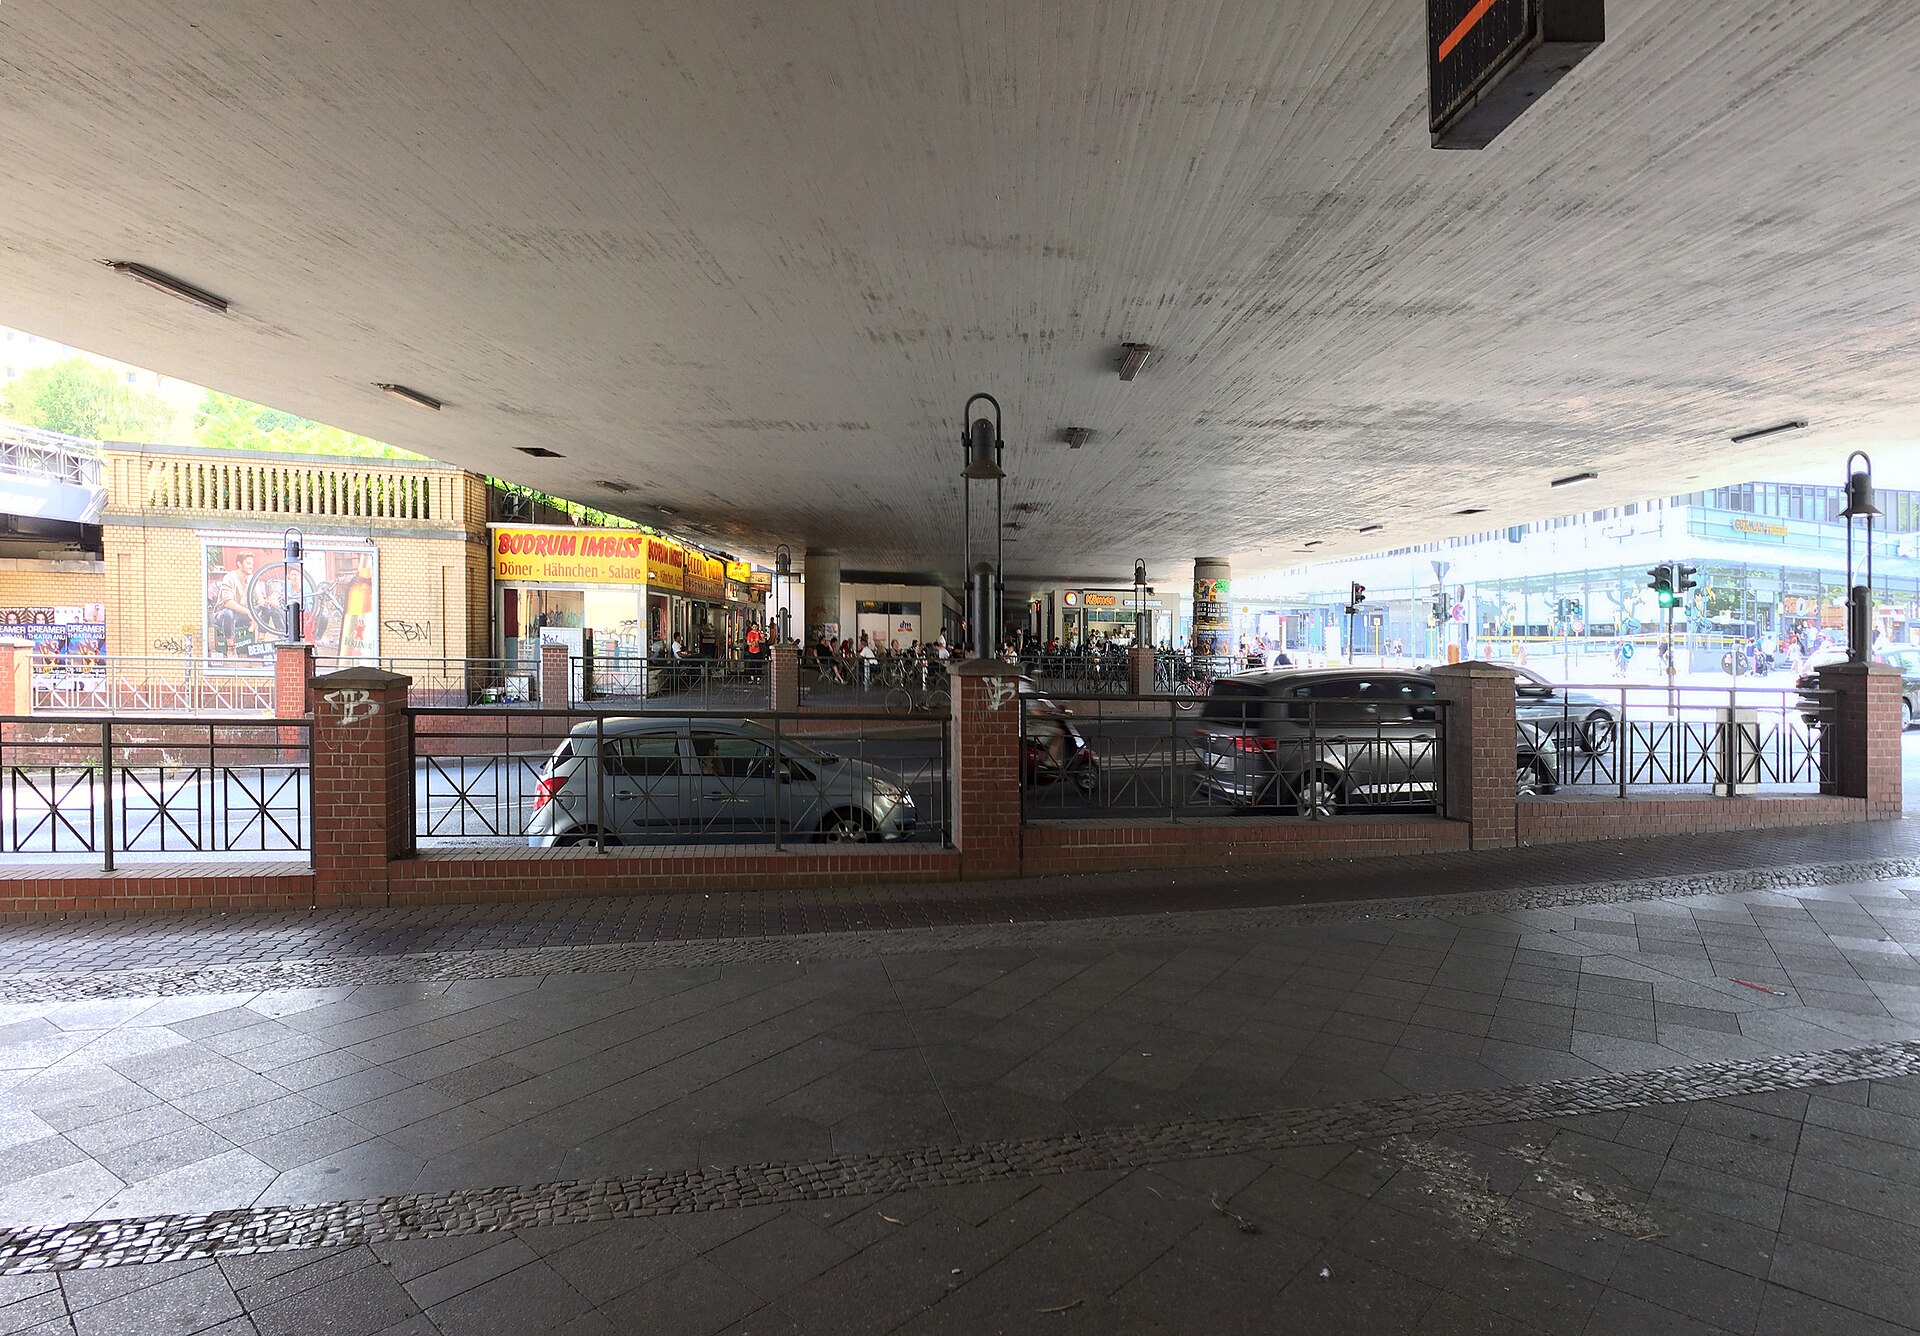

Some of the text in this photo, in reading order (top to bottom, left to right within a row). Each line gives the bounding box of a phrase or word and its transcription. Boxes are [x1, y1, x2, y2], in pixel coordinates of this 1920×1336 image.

[498, 533, 642, 558] BODRUM IMBISS
[500, 562, 533, 576] Döner
[543, 563, 598, 578] Hähnchen
[608, 565, 641, 579] Salate
[27, 625, 66, 634] DREAMER
[67, 624, 105, 632] DREAMER
